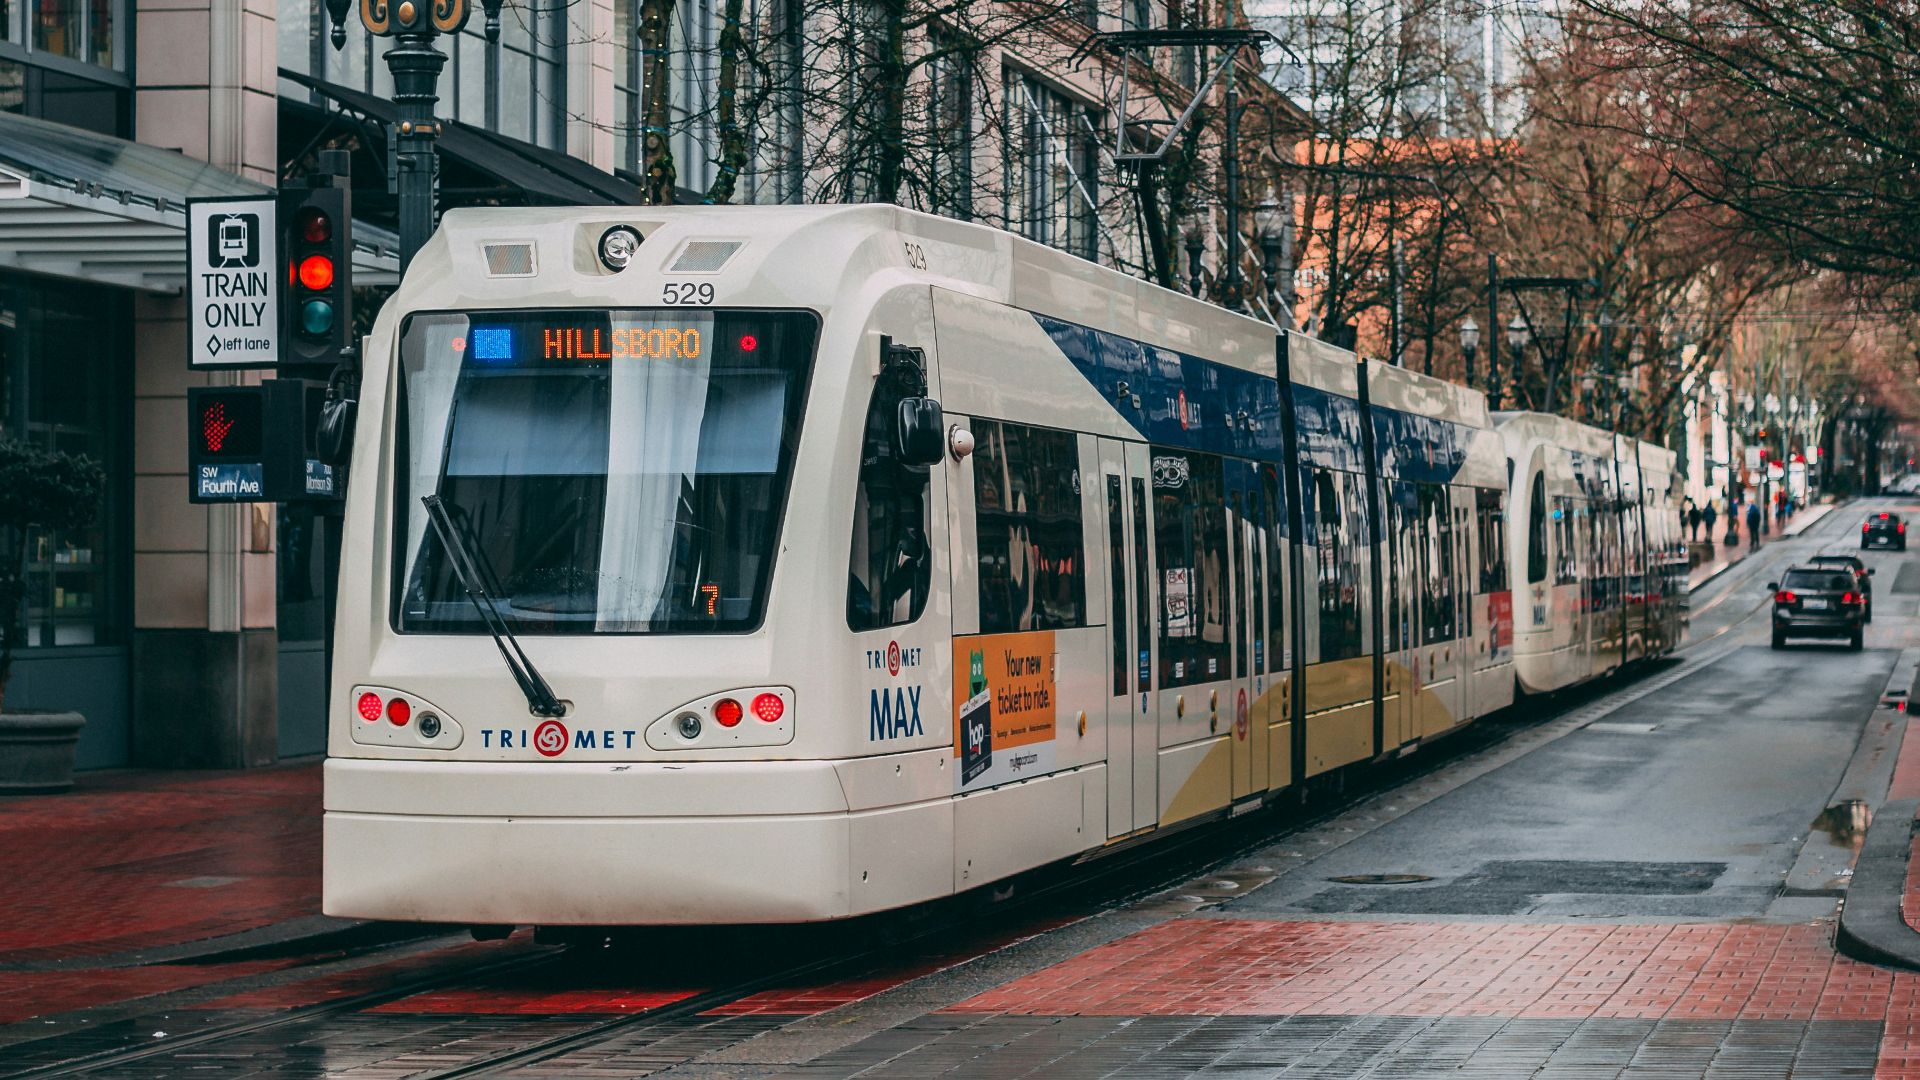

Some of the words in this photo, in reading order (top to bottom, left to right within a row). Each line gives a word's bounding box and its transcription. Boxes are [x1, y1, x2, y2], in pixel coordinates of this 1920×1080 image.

[904, 242, 926, 271] 529
[201, 272, 267, 297] TRAIN
[662, 282, 715, 305] 529
[205, 302, 266, 328] ONLY
[223, 337, 242, 350] left
[244, 337, 270, 350] lane
[544, 328, 700, 359] HILLSBORO
[202, 467, 218, 478] SW
[202, 479, 237, 494] Fourth
[239, 479, 259, 493] Ave
[702, 585, 718, 615] 7
[1005, 649, 1024, 678] Your
[1025, 655, 1041, 676] new
[998, 683, 1022, 715] ticket
[1023, 686, 1032, 712] to
[1033, 680, 1050, 710] ride.
[870, 686, 923, 741] MAX
[481, 729, 527, 748] TRI
[574, 730, 636, 749] MET
[969, 720, 984, 755] hop
